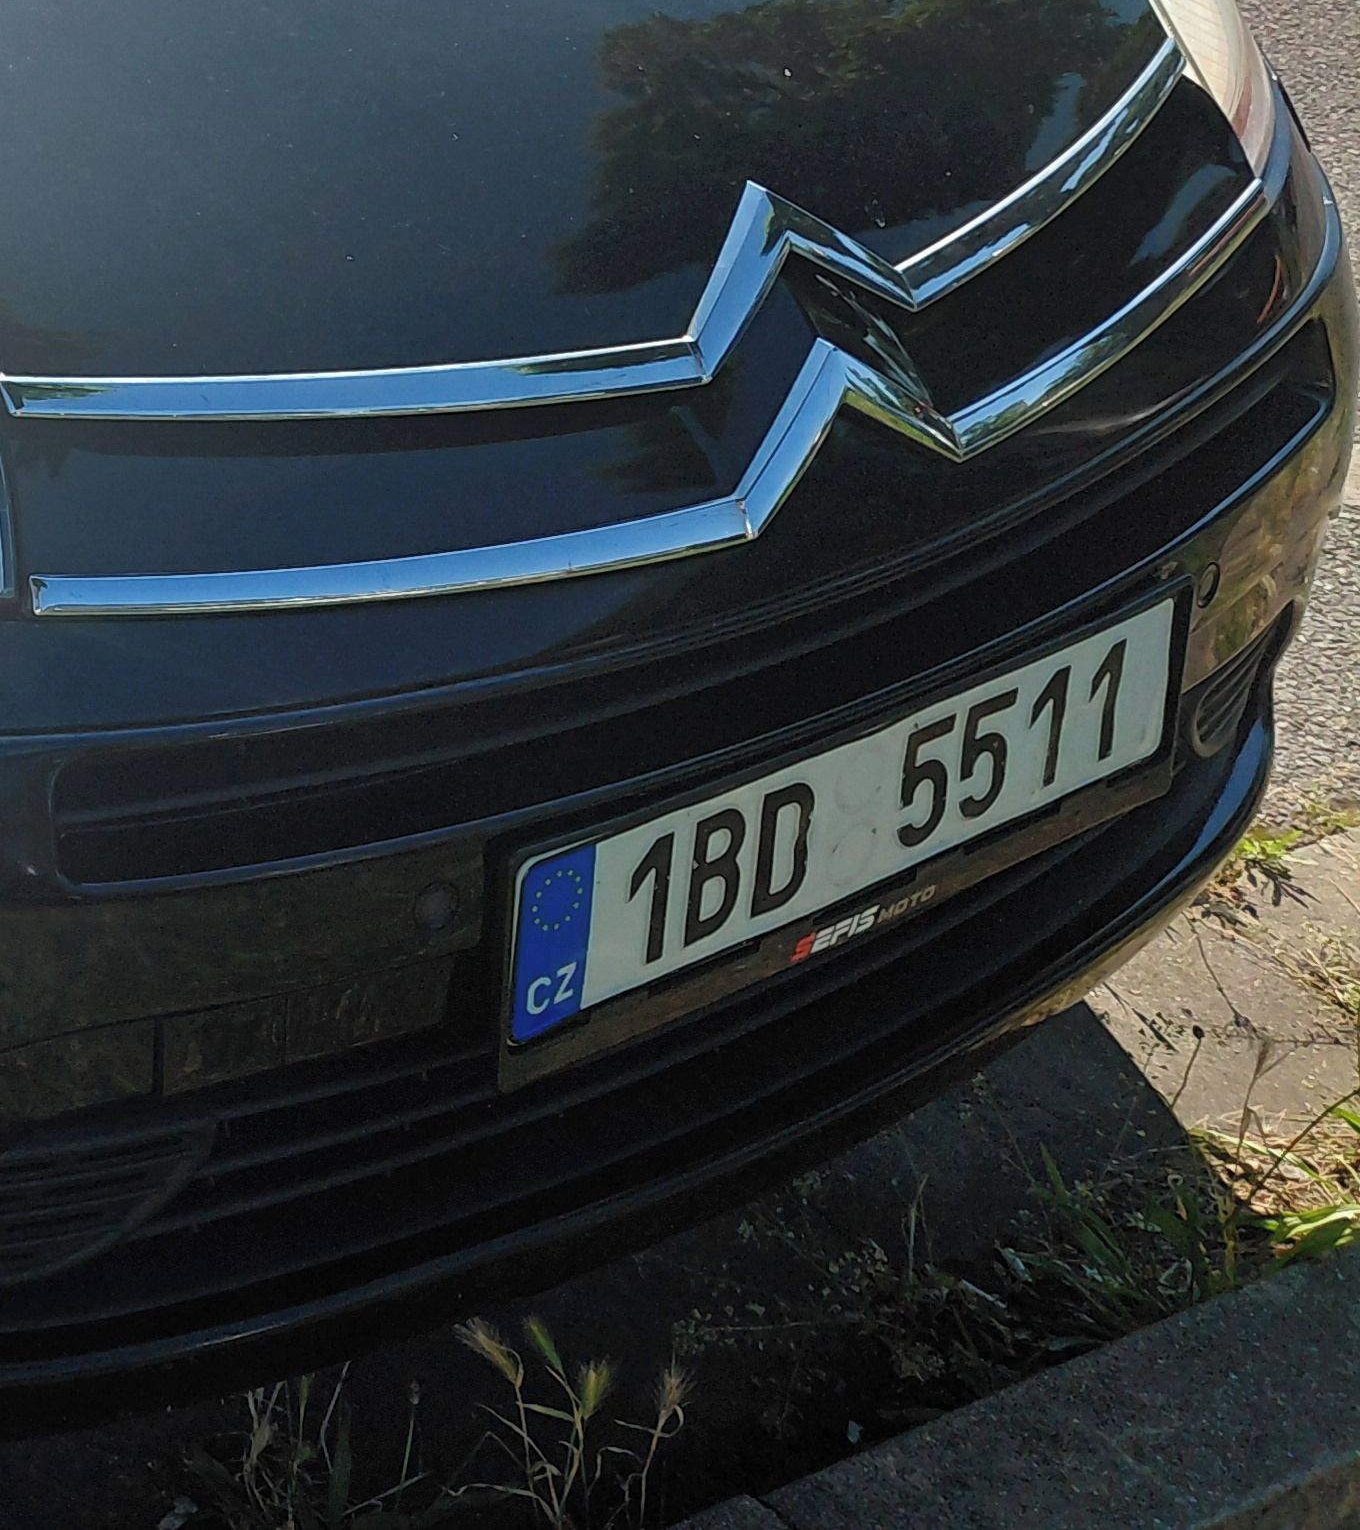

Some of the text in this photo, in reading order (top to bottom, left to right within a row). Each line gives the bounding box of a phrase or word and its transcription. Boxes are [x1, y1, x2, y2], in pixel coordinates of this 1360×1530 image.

[628, 637, 1128, 966] 1BD 5511
[789, 883, 938, 963] SEFIS MOTO
[525, 961, 576, 1017] CZ
